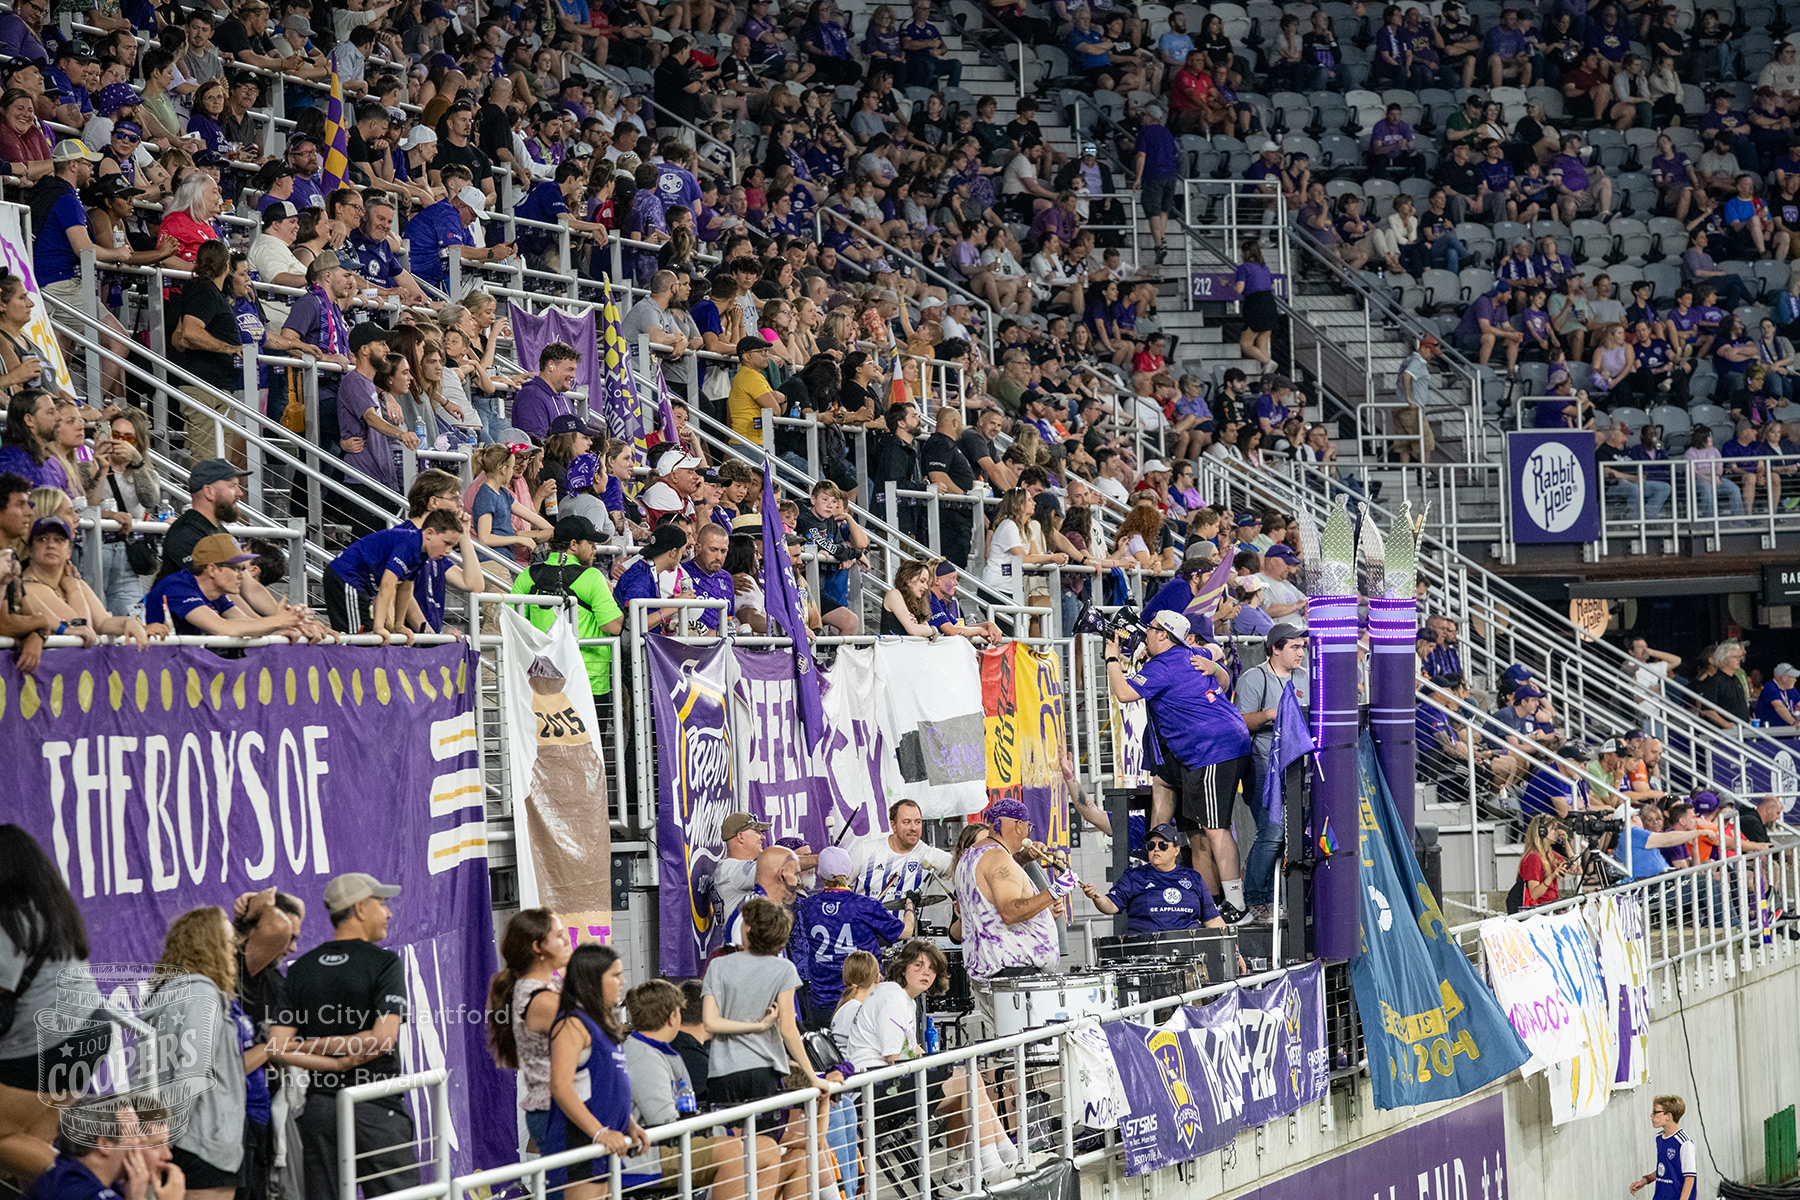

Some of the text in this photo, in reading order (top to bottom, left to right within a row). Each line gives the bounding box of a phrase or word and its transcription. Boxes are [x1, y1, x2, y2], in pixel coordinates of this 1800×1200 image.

[1193, 277, 1212, 295] 212
[1530, 454, 1576, 505] Rabbit
[1544, 485, 1572, 530] Hole
[534, 707, 586, 738] 2015
[278, 725, 330, 875] OF
[810, 923, 858, 963] 24
